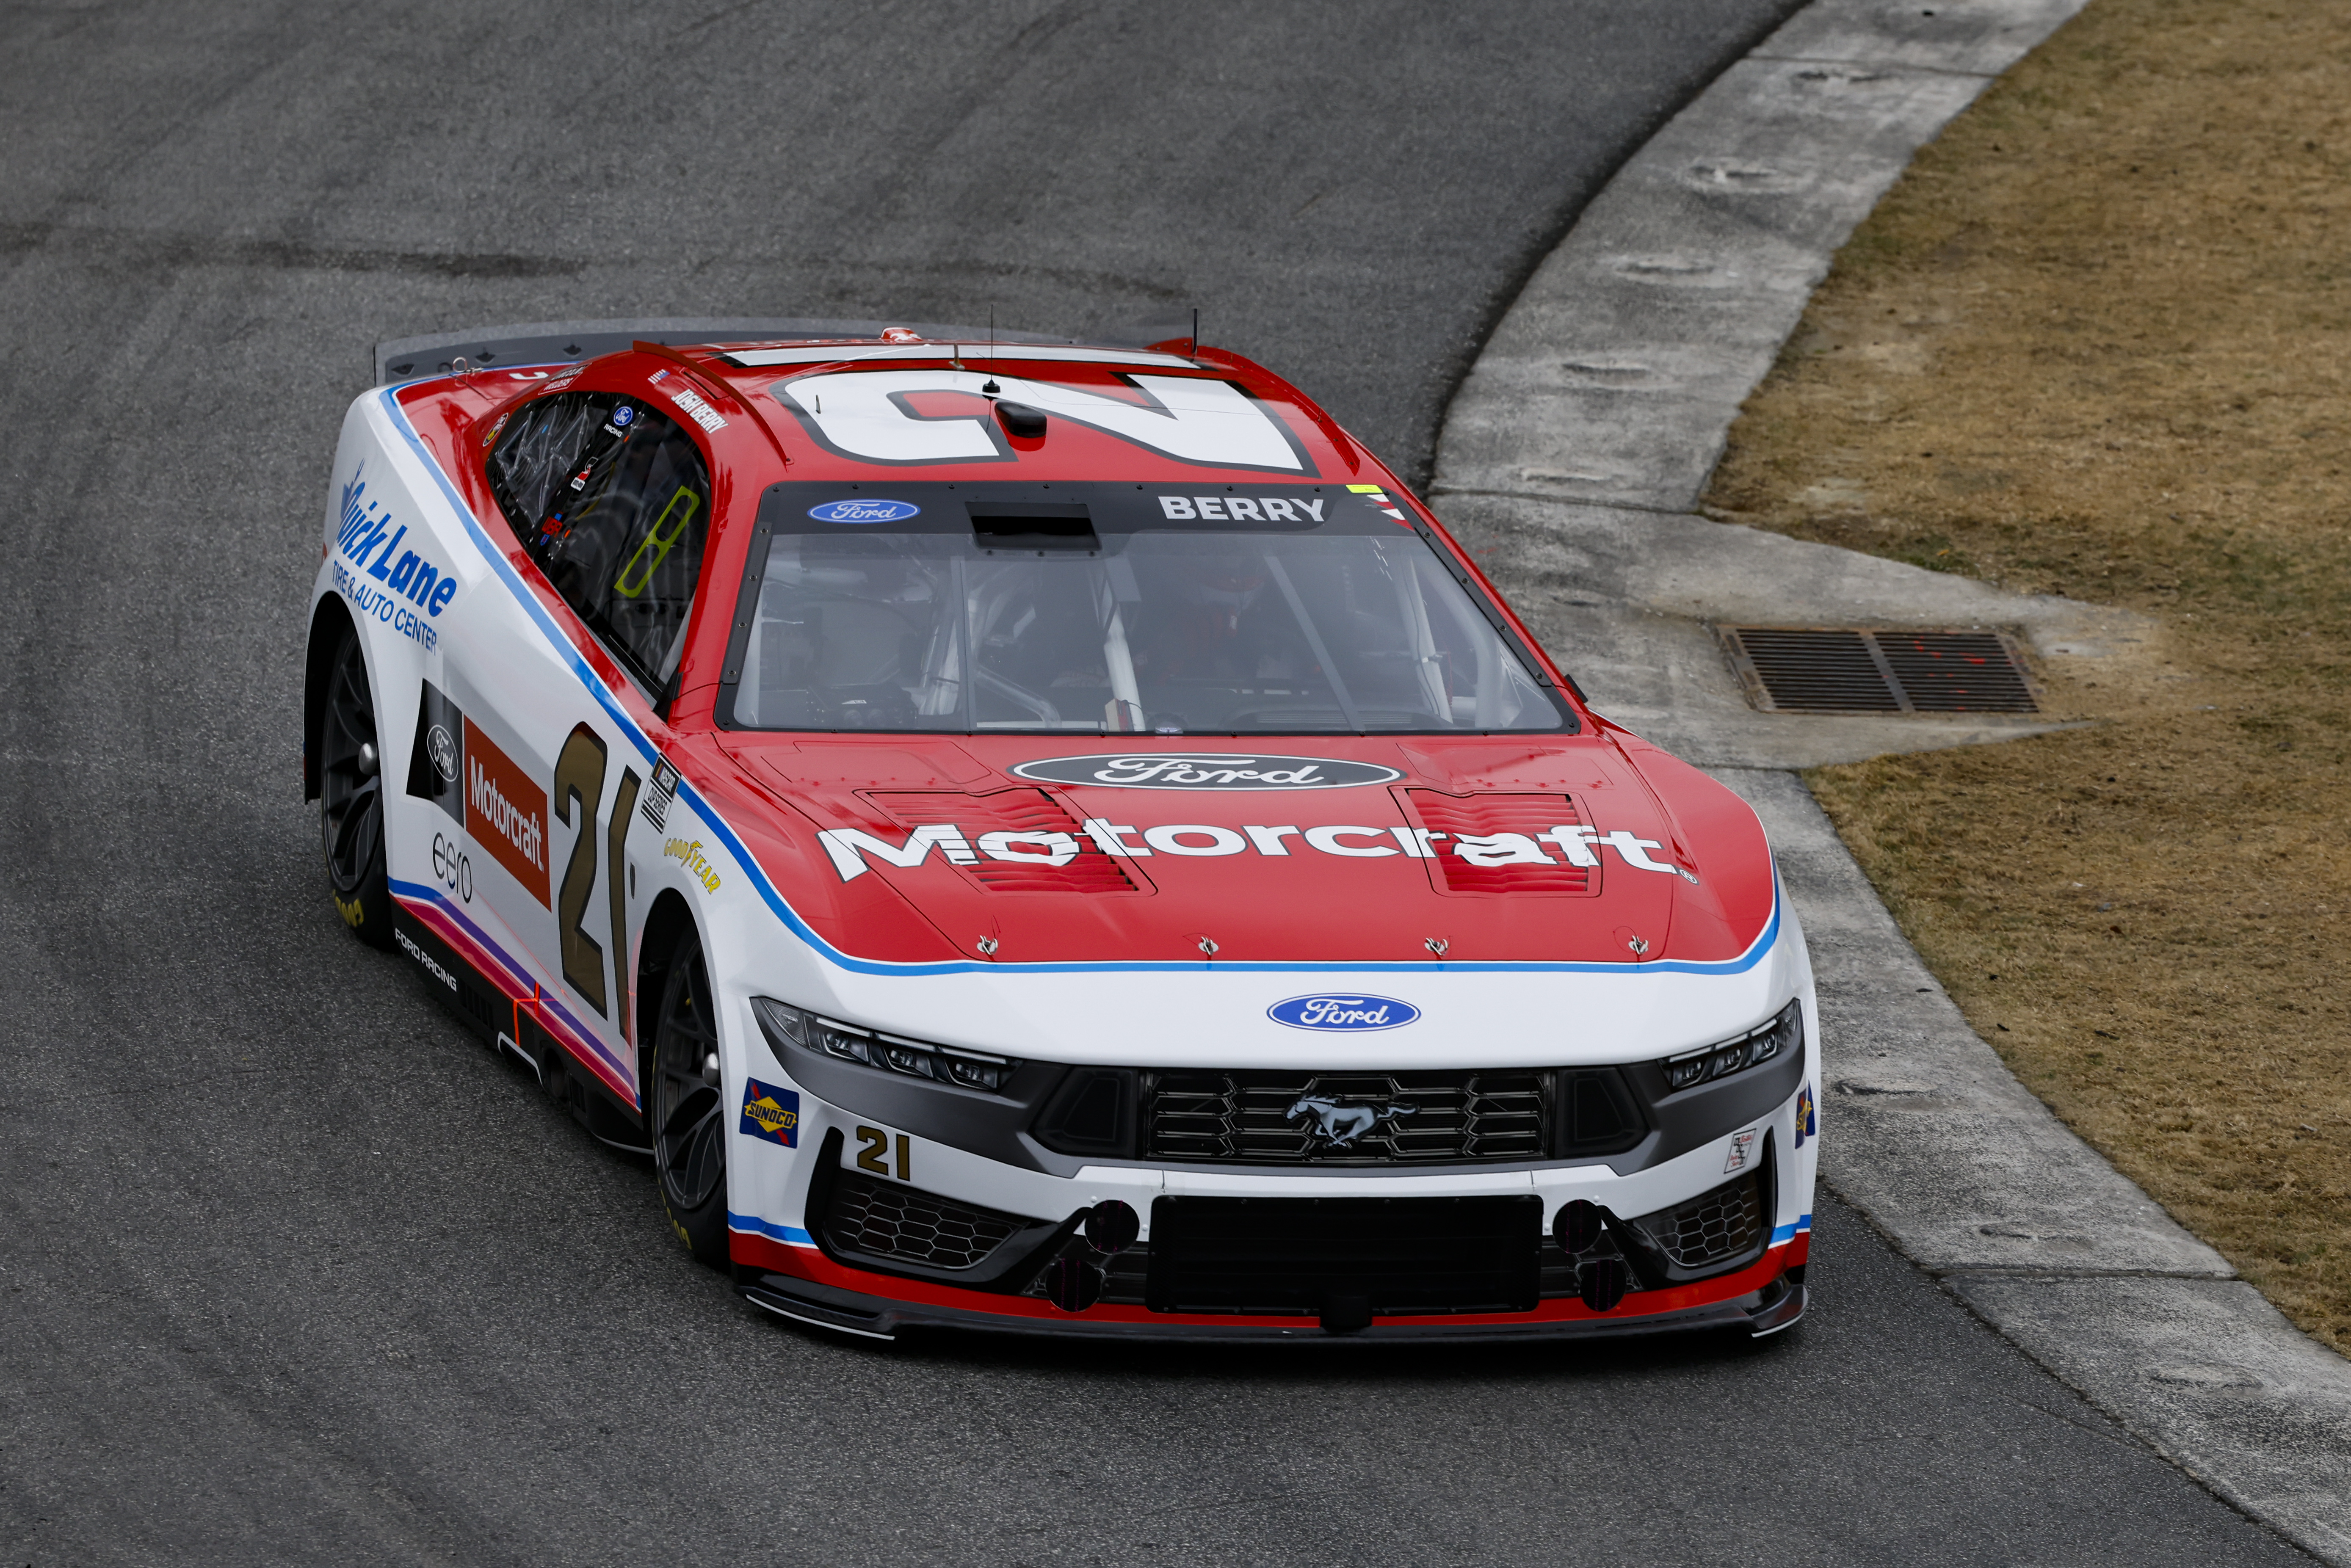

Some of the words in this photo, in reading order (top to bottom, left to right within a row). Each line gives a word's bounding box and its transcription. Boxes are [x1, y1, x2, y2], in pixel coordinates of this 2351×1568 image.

[603, 423, 623, 438] RACING
[616, 408, 630, 423] Ford
[670, 388, 701, 414] JOSH
[690, 400, 729, 434] BERRY
[831, 502, 897, 520] Ford
[1158, 496, 1324, 522] BERRY
[366, 525, 457, 618] Lane
[332, 559, 349, 594] TIRE
[347, 576, 356, 601] &
[354, 583, 394, 622] AUTO
[395, 608, 437, 656] CENTER
[433, 730, 453, 775] Ford
[1094, 757, 1325, 785] Ford
[471, 754, 543, 872] Motorcraft
[432, 832, 472, 904] eero
[815, 817, 1679, 884] Motorcraft
[554, 721, 641, 1050] 21
[395, 927, 420, 960] FORD
[421, 950, 457, 992] RACING
[1299, 998, 1390, 1026] Ford
[747, 1101, 794, 1127] SUNOCO
[856, 1125, 911, 1182] 21
